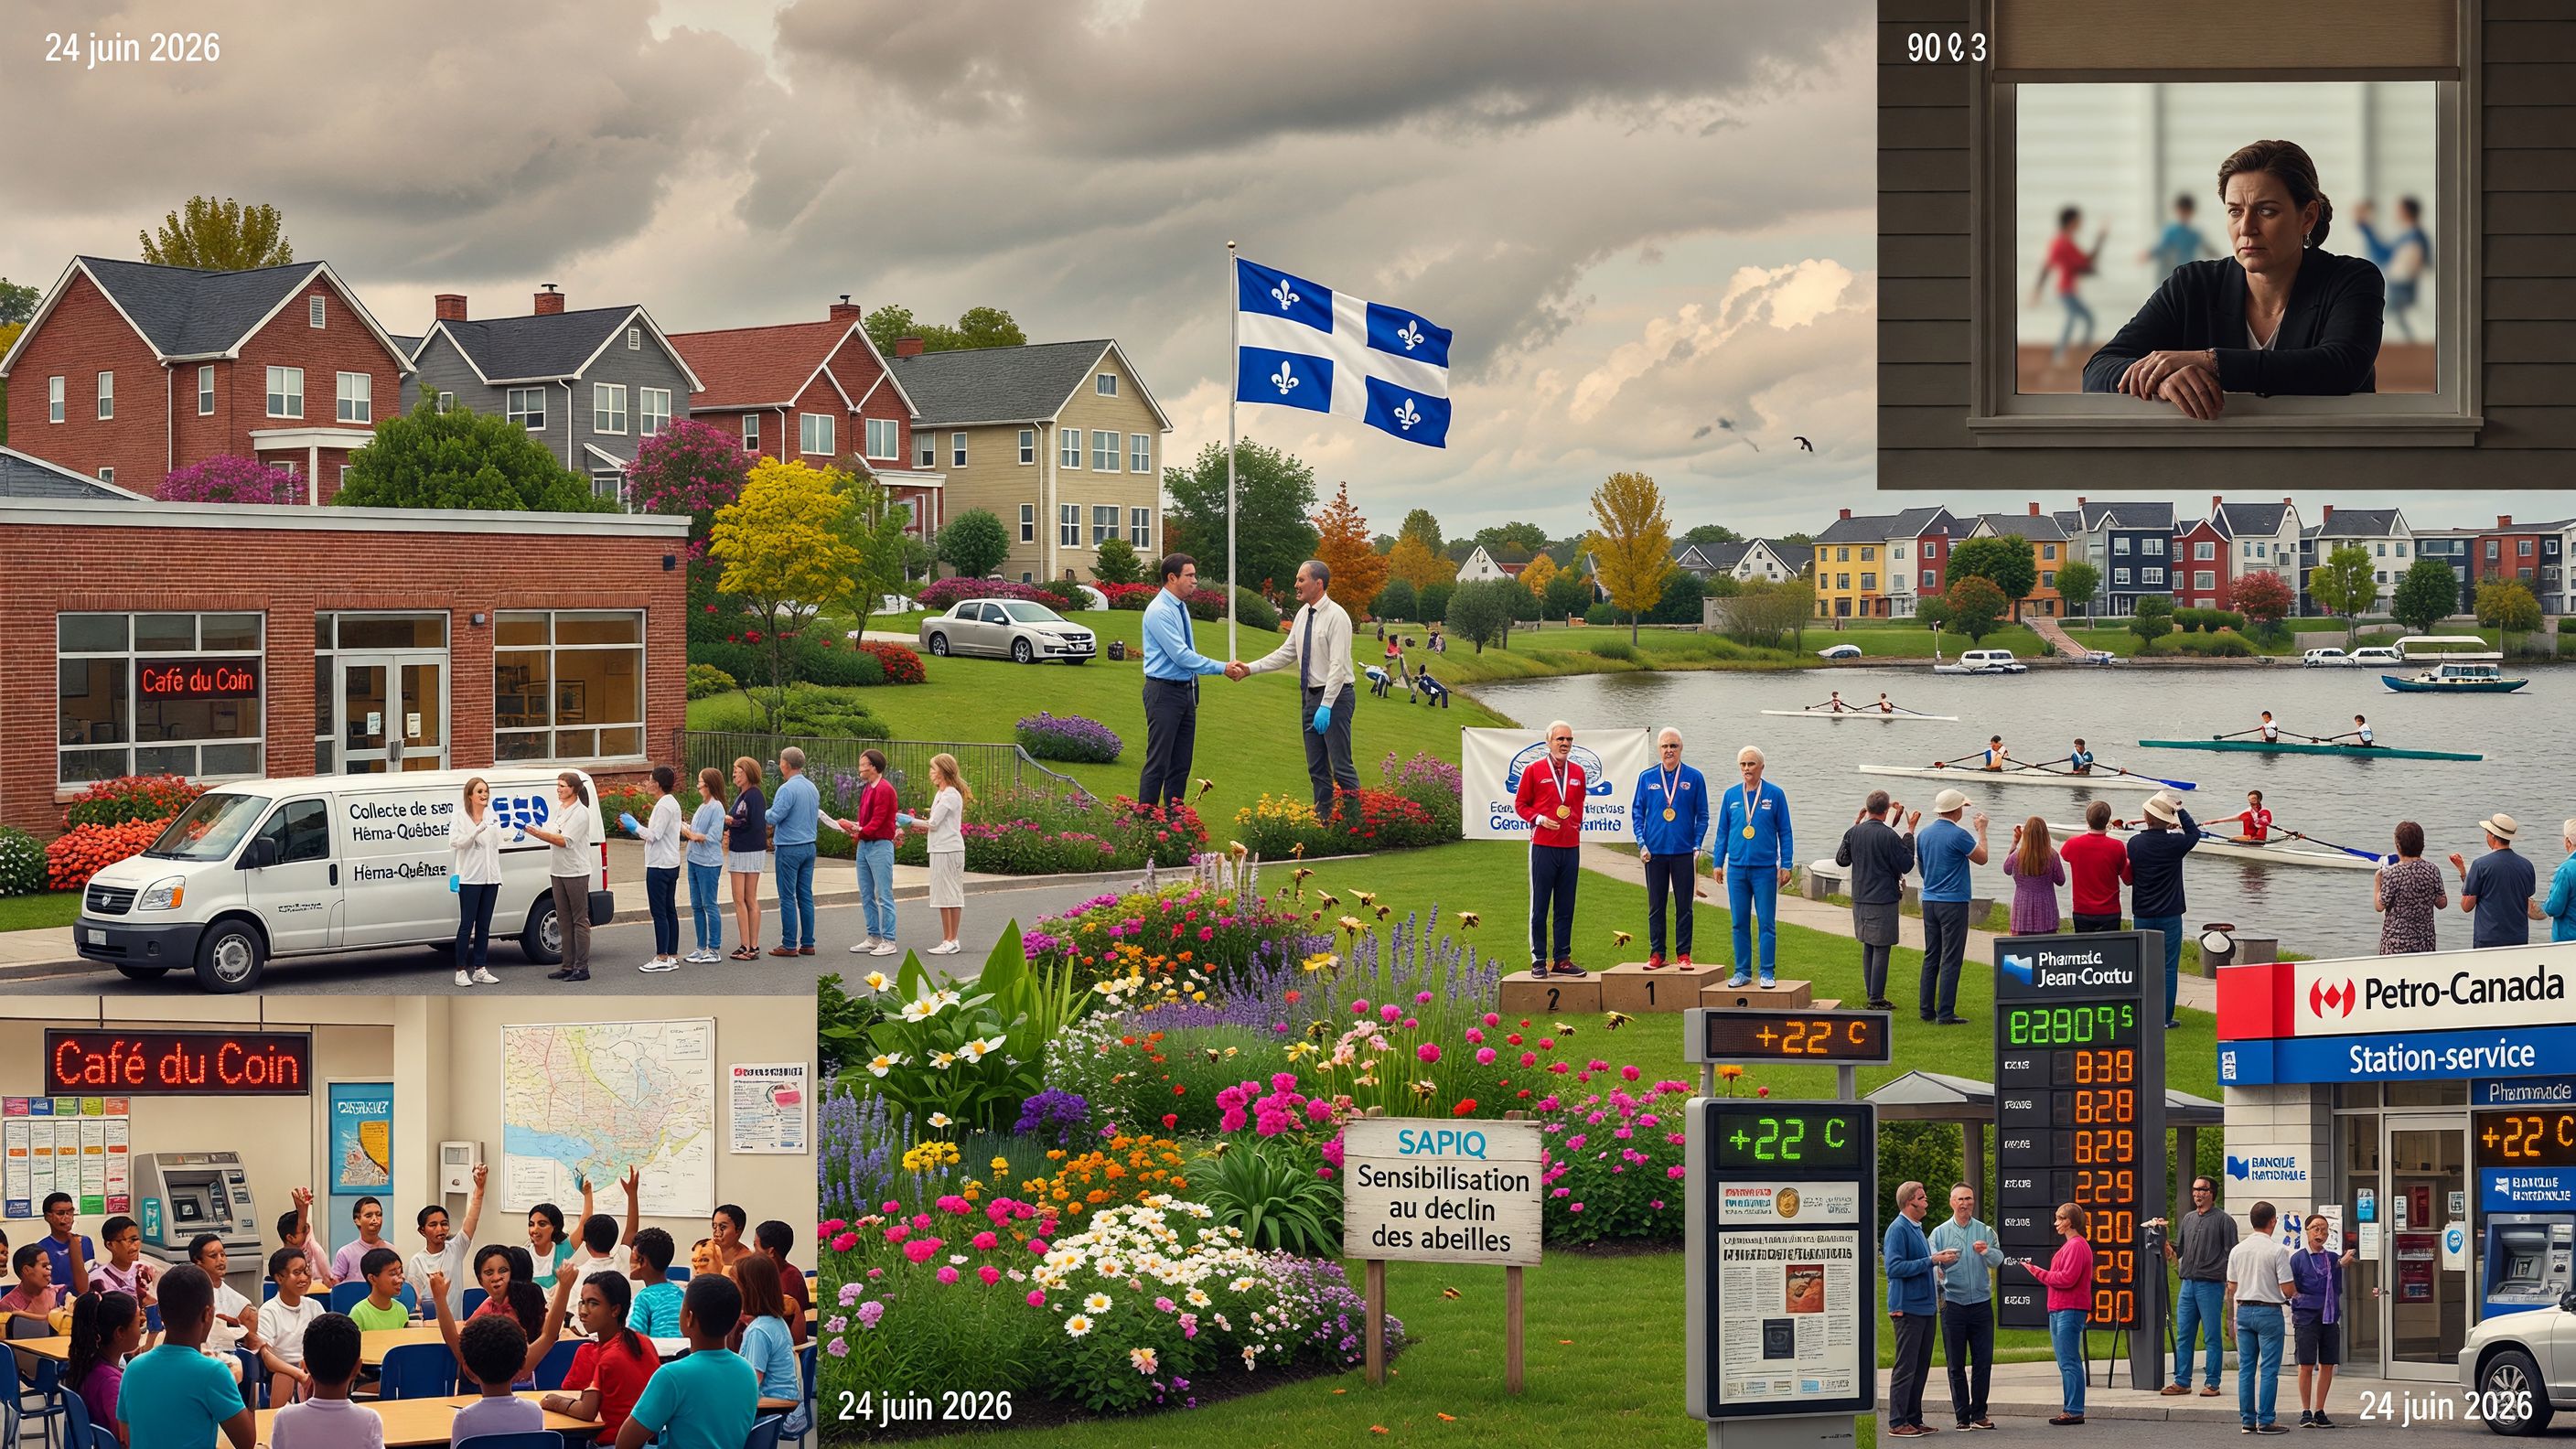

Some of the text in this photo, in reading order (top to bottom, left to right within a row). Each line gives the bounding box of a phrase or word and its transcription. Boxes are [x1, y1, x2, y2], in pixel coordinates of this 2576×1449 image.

[143, 667, 253, 692] Café du Coin
[349, 802, 407, 820] Collecte
[411, 800, 427, 816] de
[1547, 988, 1561, 1011] 2
[1645, 981, 1655, 1005] 1
[2366, 964, 2565, 1010] Petro-Canada
[1755, 1020, 1867, 1054] +22 C
[56, 1040, 298, 1084] Café du Coin
[2349, 1037, 2536, 1074] Station-service
[1399, 1129, 1487, 1160] SAPIQ
[1729, 1118, 1845, 1160] +22 C
[2076, 1130, 2133, 1164] 829
[2482, 1115, 2574, 1157] +22 C
[1358, 1164, 1530, 1192] Sensibilisation
[2075, 1170, 2133, 1204] 229
[1390, 1196, 1495, 1221] au déclin
[1372, 1223, 1510, 1252] des abeilles
[2096, 1250, 2133, 1283] 29
[2095, 1290, 2133, 1323] 80
